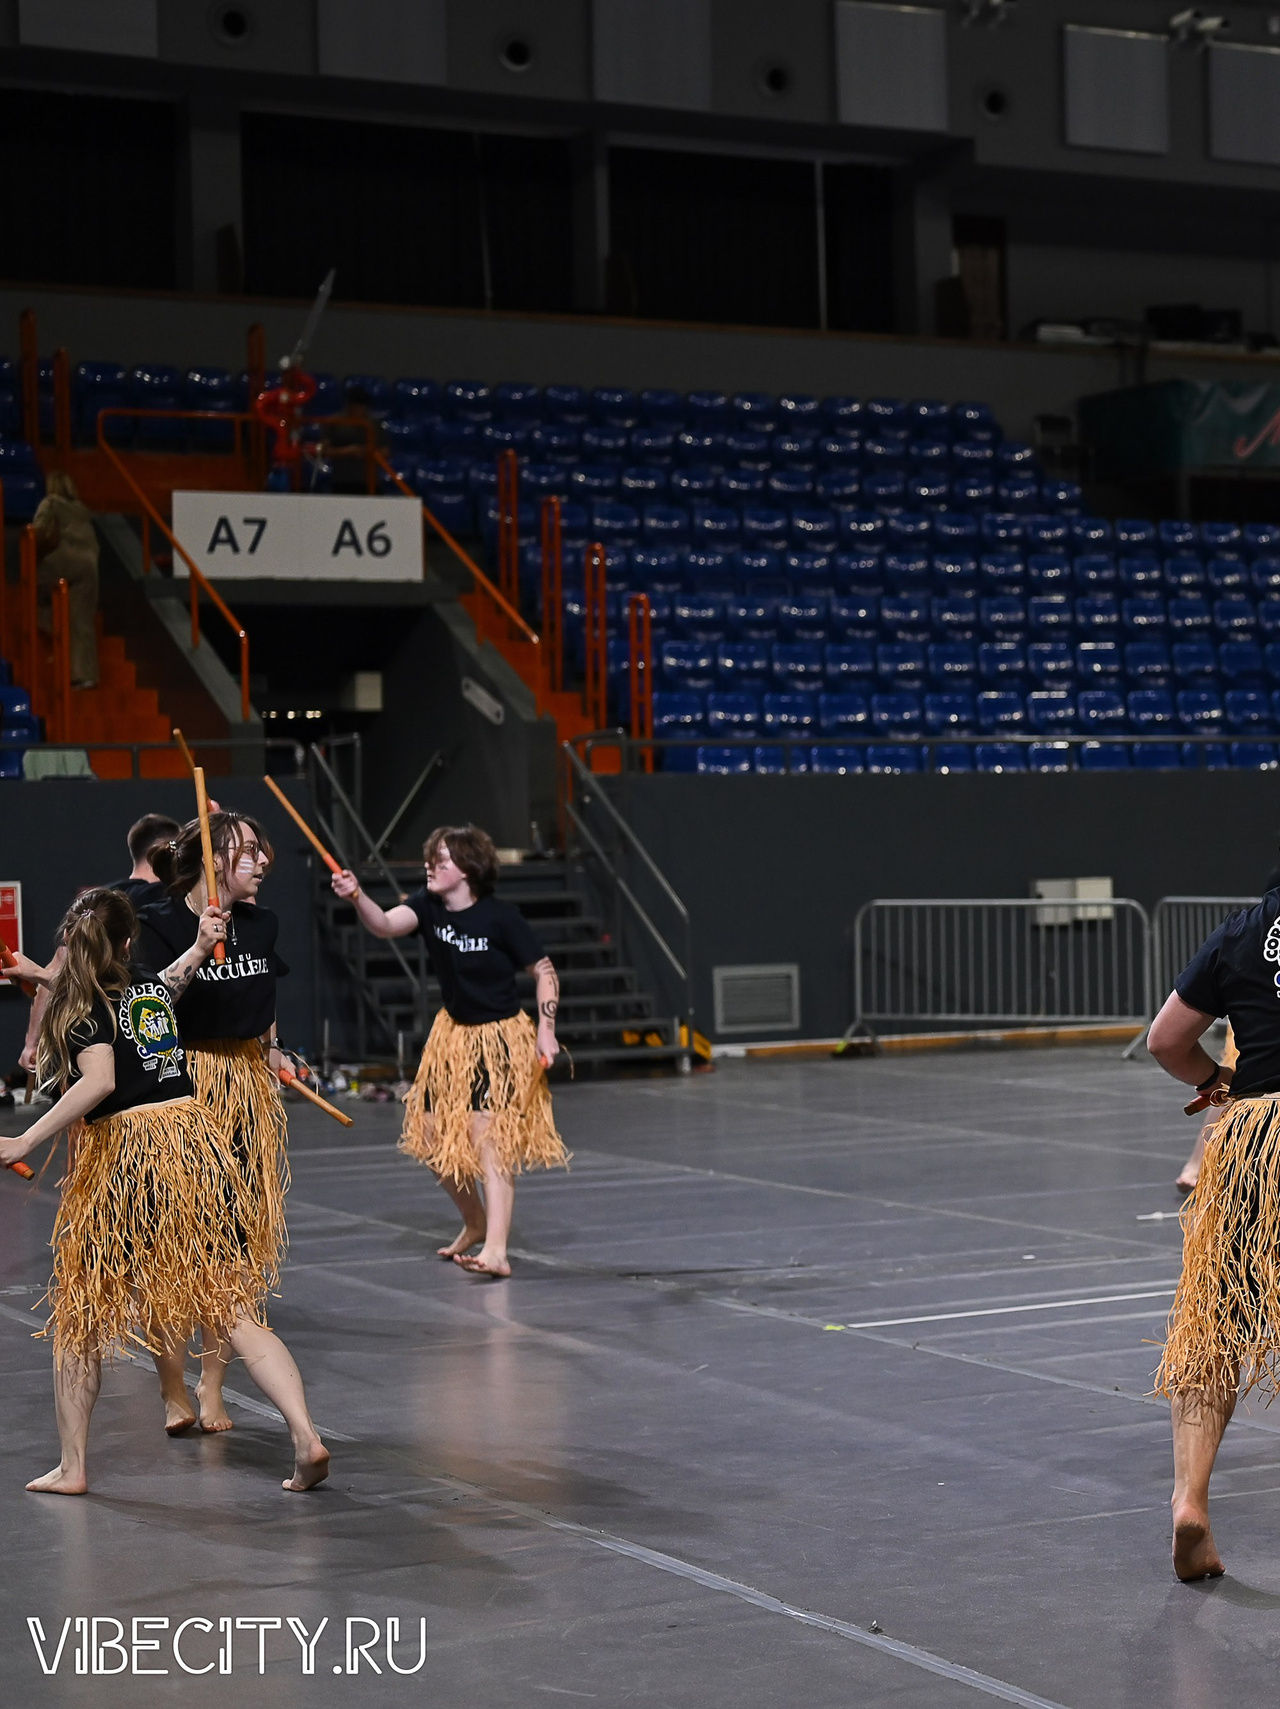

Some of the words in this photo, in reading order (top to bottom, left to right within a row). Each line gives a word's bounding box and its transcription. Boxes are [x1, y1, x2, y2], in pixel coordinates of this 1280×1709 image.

[207, 515, 267, 555] A7
[331, 518, 392, 557] A6
[196, 958, 269, 981] MACULELE
[209, 957, 232, 967] SU
[134, 984, 153, 996] DE
